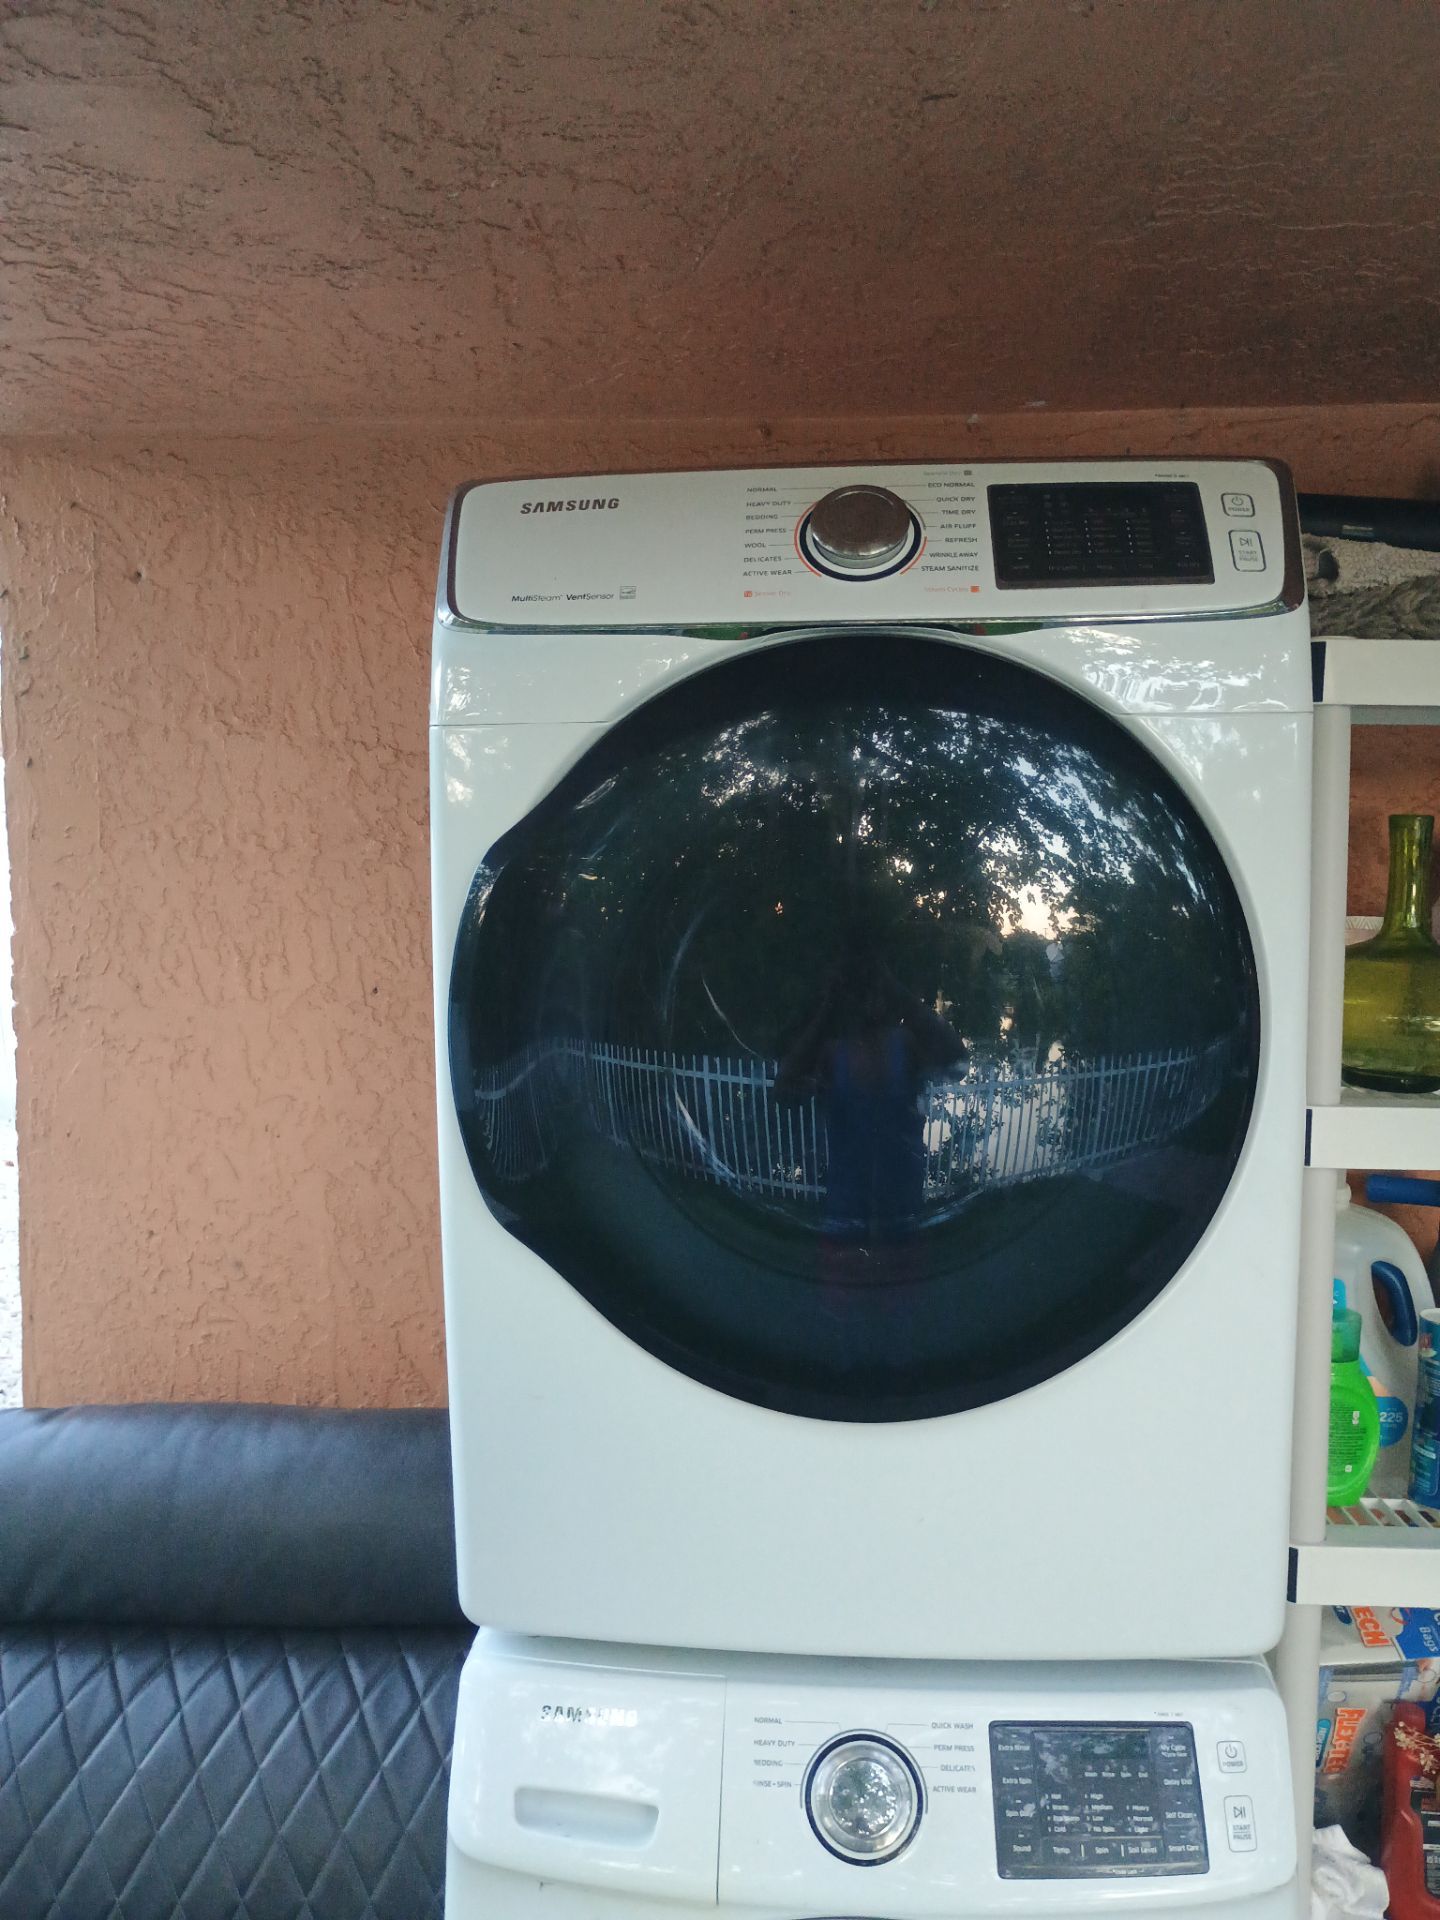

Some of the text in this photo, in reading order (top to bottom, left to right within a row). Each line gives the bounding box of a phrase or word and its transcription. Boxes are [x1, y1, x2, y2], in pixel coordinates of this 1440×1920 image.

[520, 498, 620, 514] SAMSUNG
[566, 593, 614, 601] VentSensor
[1380, 1412, 1403, 1423] 225
[1354, 1607, 1391, 1645] ECH
[1419, 1626, 1439, 1653] Bags
[754, 1717, 782, 1725] NORMAL
